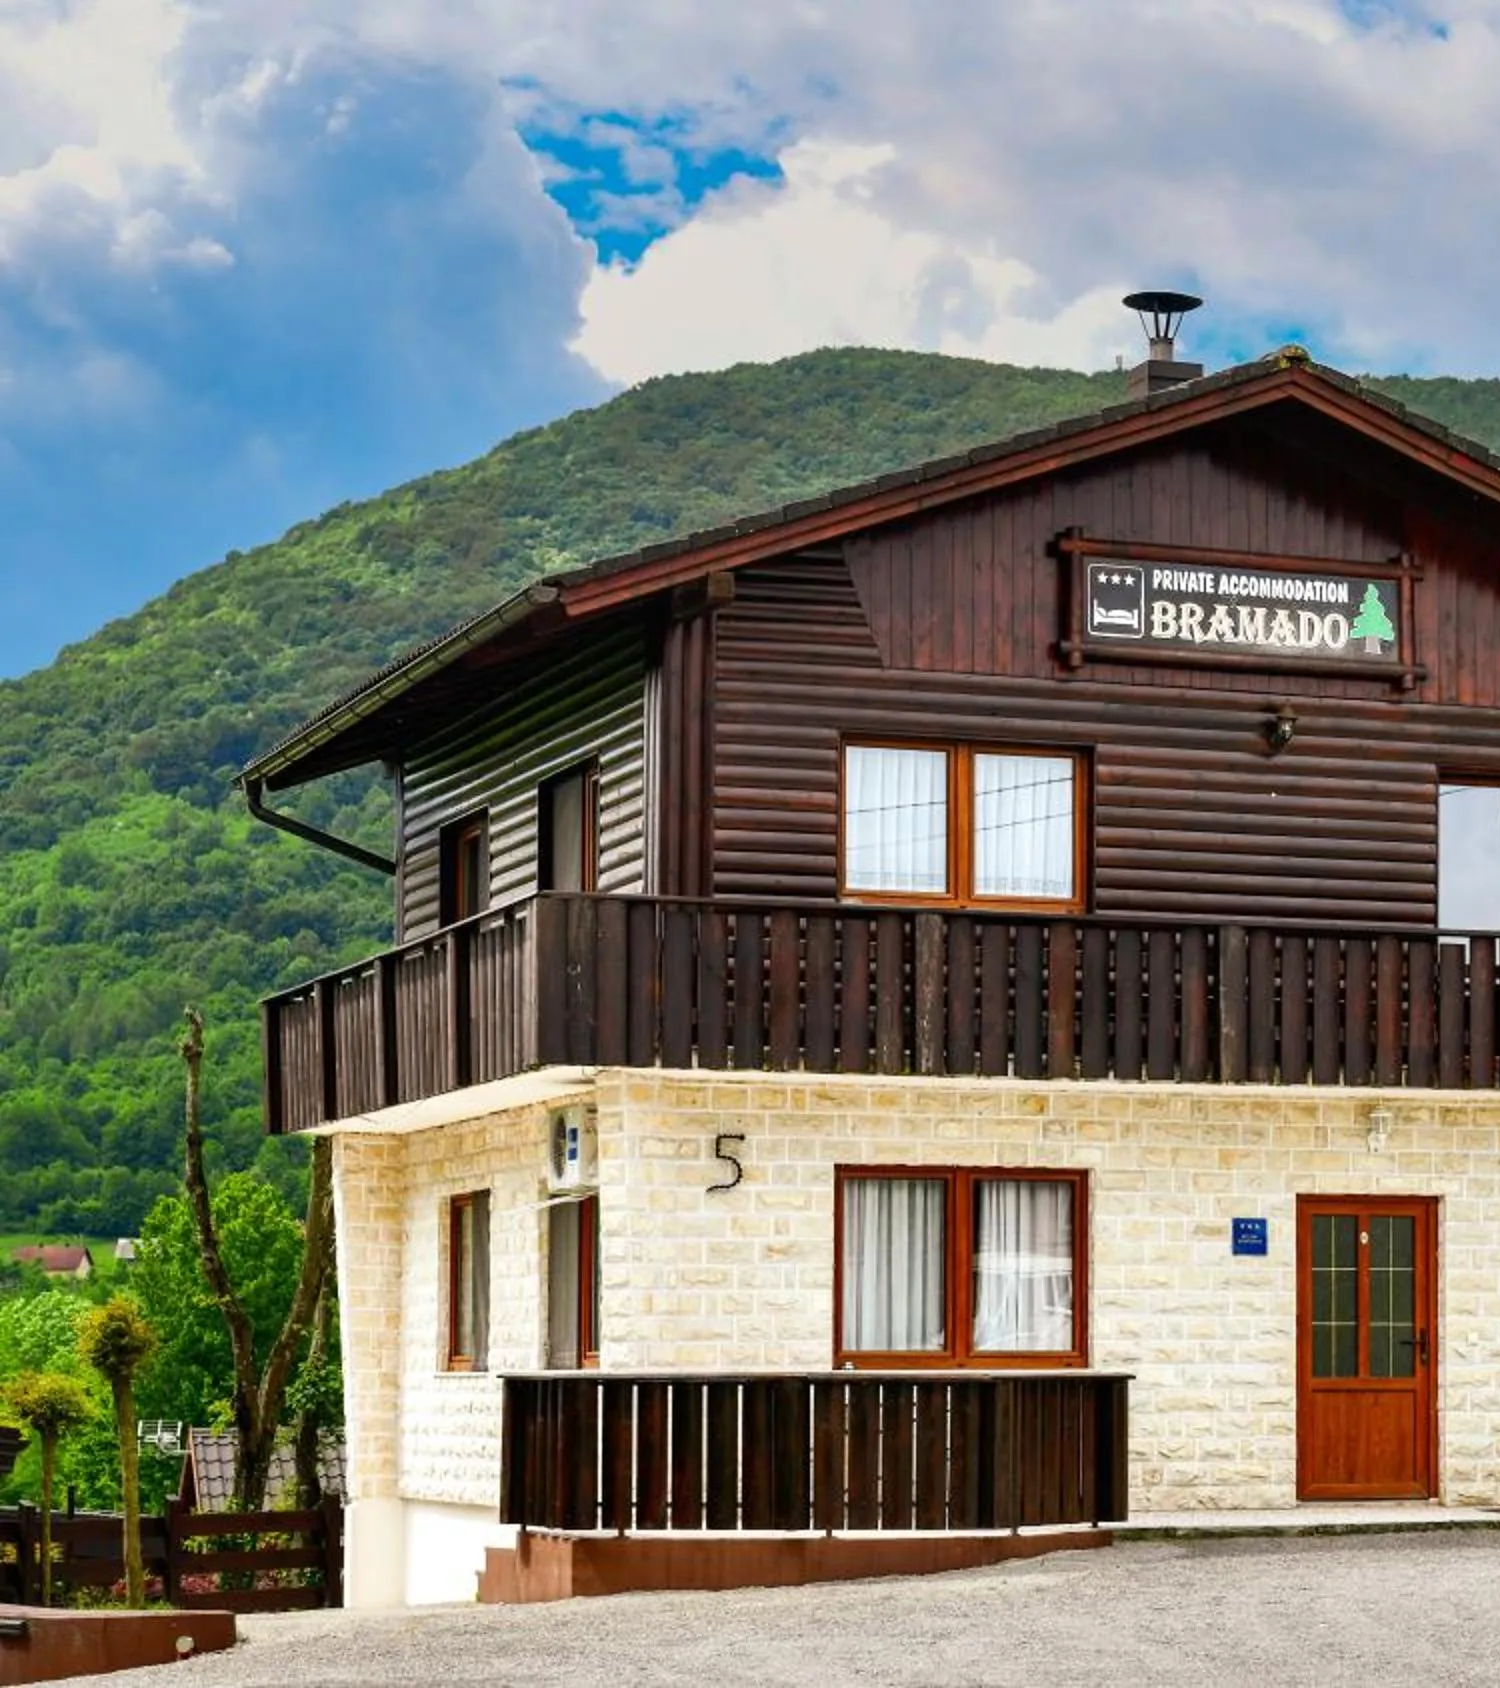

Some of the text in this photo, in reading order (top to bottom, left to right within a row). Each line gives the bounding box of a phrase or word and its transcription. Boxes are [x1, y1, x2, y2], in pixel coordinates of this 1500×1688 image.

[1152, 569, 1349, 602] PRIVATE ACCOMMODATION
[1151, 600, 1349, 649] BRAMADO
[706, 1133, 745, 1192] 5
